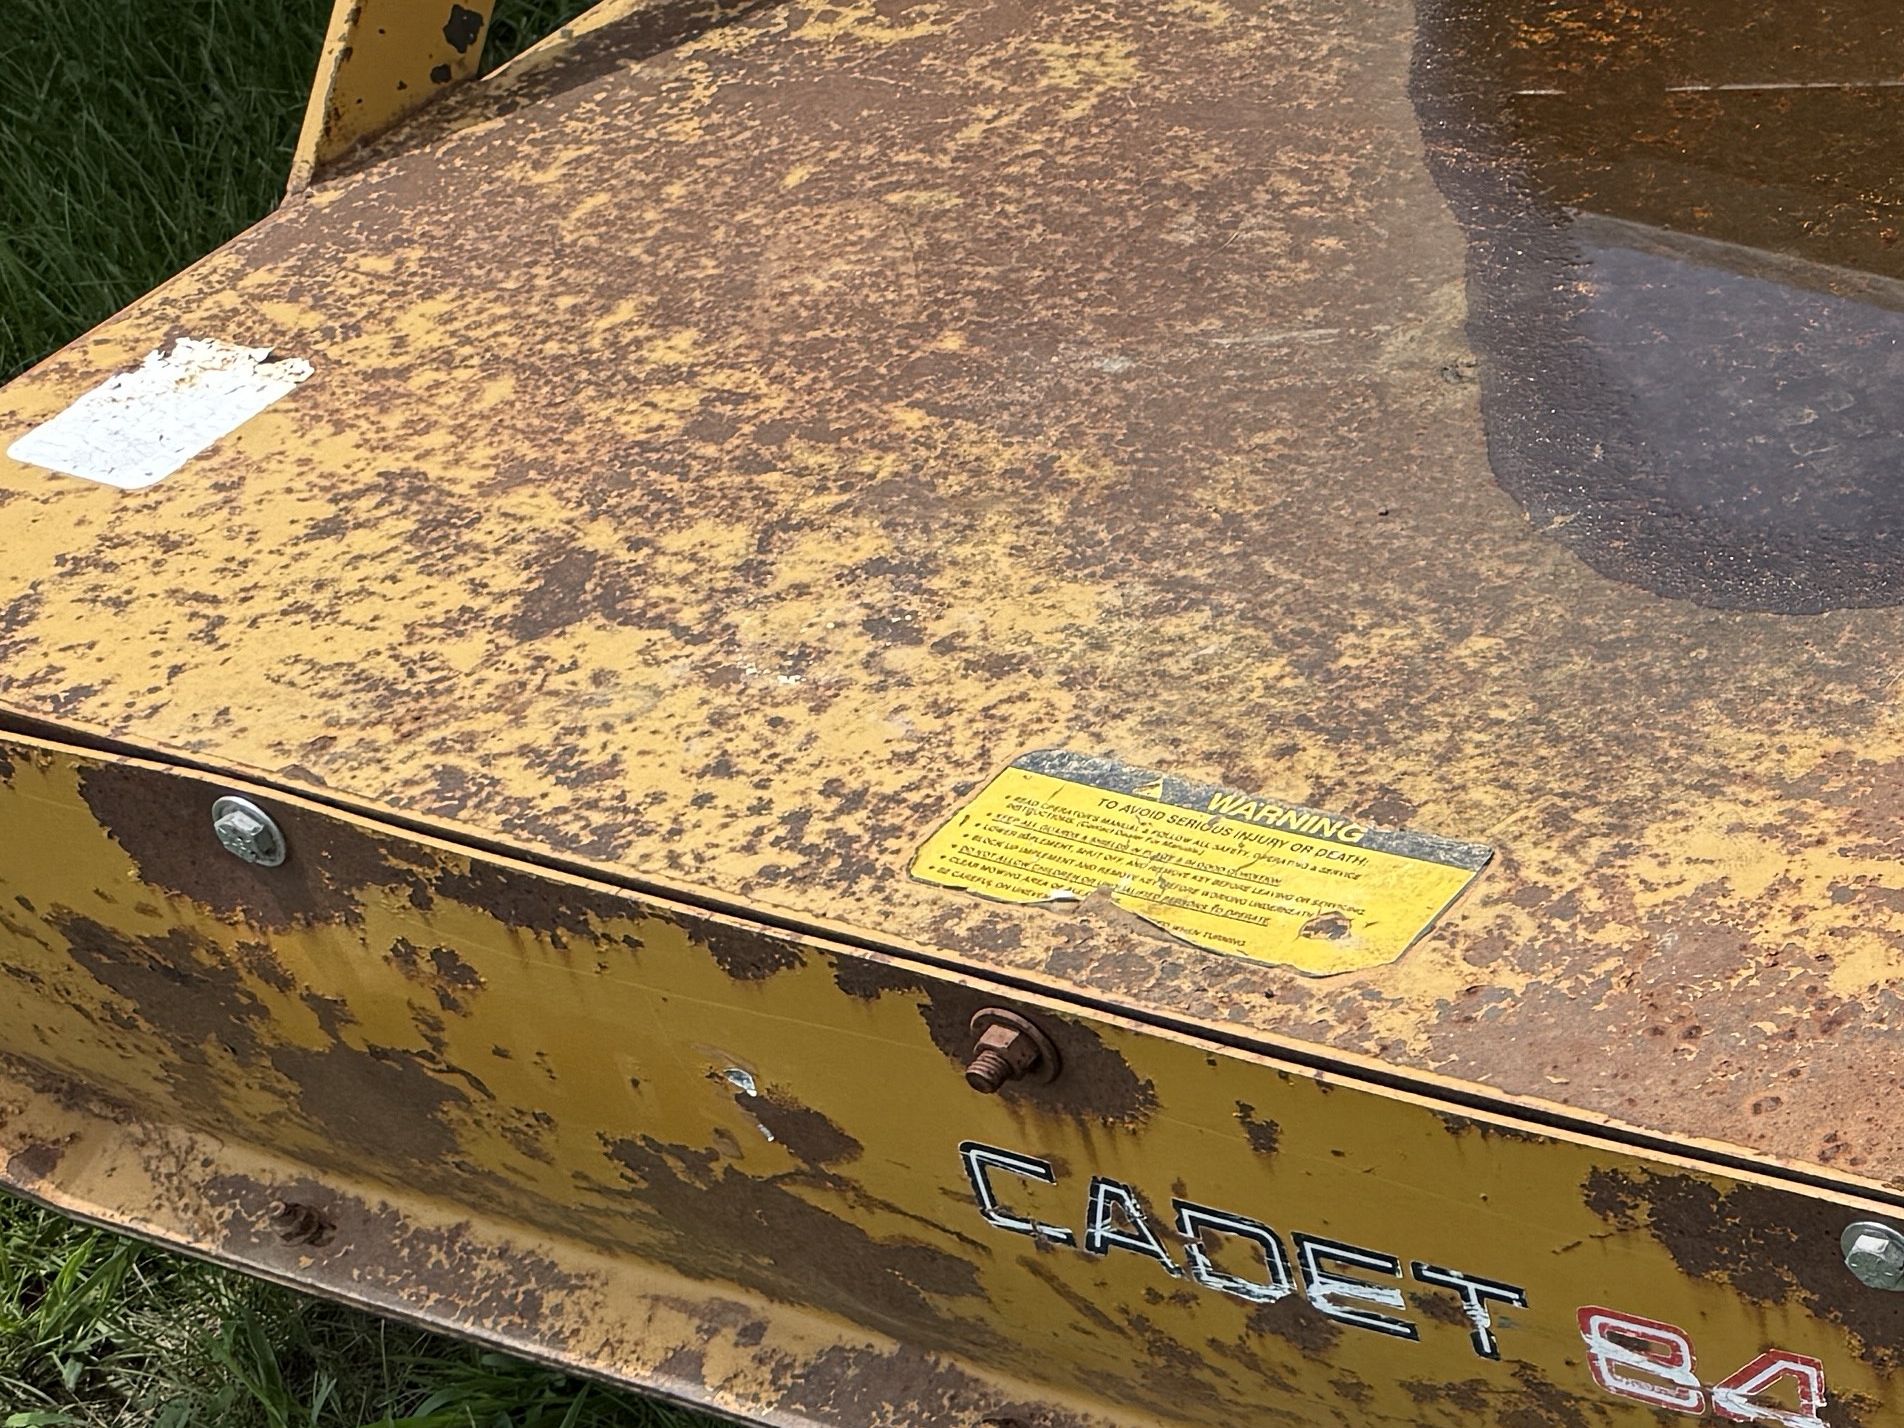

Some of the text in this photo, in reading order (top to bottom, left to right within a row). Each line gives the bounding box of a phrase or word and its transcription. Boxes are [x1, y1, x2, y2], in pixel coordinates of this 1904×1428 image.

[993, 813, 1020, 824] KEEP
[1020, 819, 1037, 828] ALL
[1039, 824, 1080, 840] GUARDS
[1090, 837, 1129, 850] SHIELDS
[1013, 796, 1039, 807] READ
[1101, 817, 1139, 832] MANUAL
[1151, 829, 1193, 843] FOLLOW
[1193, 839, 1210, 849] ALL
[1252, 851, 1310, 870] OPERATING
[1318, 866, 1362, 881] SERVICE
[1098, 798, 1118, 810] TO
[1119, 804, 1166, 820] AVOID
[1166, 815, 1233, 836] SERIOUS
[1233, 830, 1290, 849] INJURY
[1290, 842, 1314, 853] OR
[1207, 792, 1368, 843] WARNING
[948, 856, 980, 869] CLEAR
[980, 863, 1021, 880] MOWING
[1021, 876, 1048, 887] AREA
[1050, 882, 1064, 891] OF
[959, 845, 974, 854] DO
[975, 849, 997, 859] NOT
[995, 855, 1031, 868] ALLOW
[1032, 863, 1081, 882] CHILDREN
[1081, 876, 1096, 885] OR
[1210, 904, 1224, 913] TO
[971, 834, 1314, 918] BLOCK UP IMPLEMENT AND REMOVE KEY BEFORE WORKING UNDERNEATH
[982, 823, 1018, 837] LOWER
[1076, 847, 1102, 859] SHUT
[1126, 859, 1148, 869] AND
[1149, 864, 1191, 879] REMOVE
[1192, 874, 1211, 884] KEY
[1212, 878, 1251, 892] BEFORE
[1251, 886, 1294, 902] LEAVING
[1295, 895, 1311, 904] OR
[994, 881, 1011, 891] ON
[1172, 925, 1200, 936] WHEN
[958, 1140, 1528, 1362] CADET
